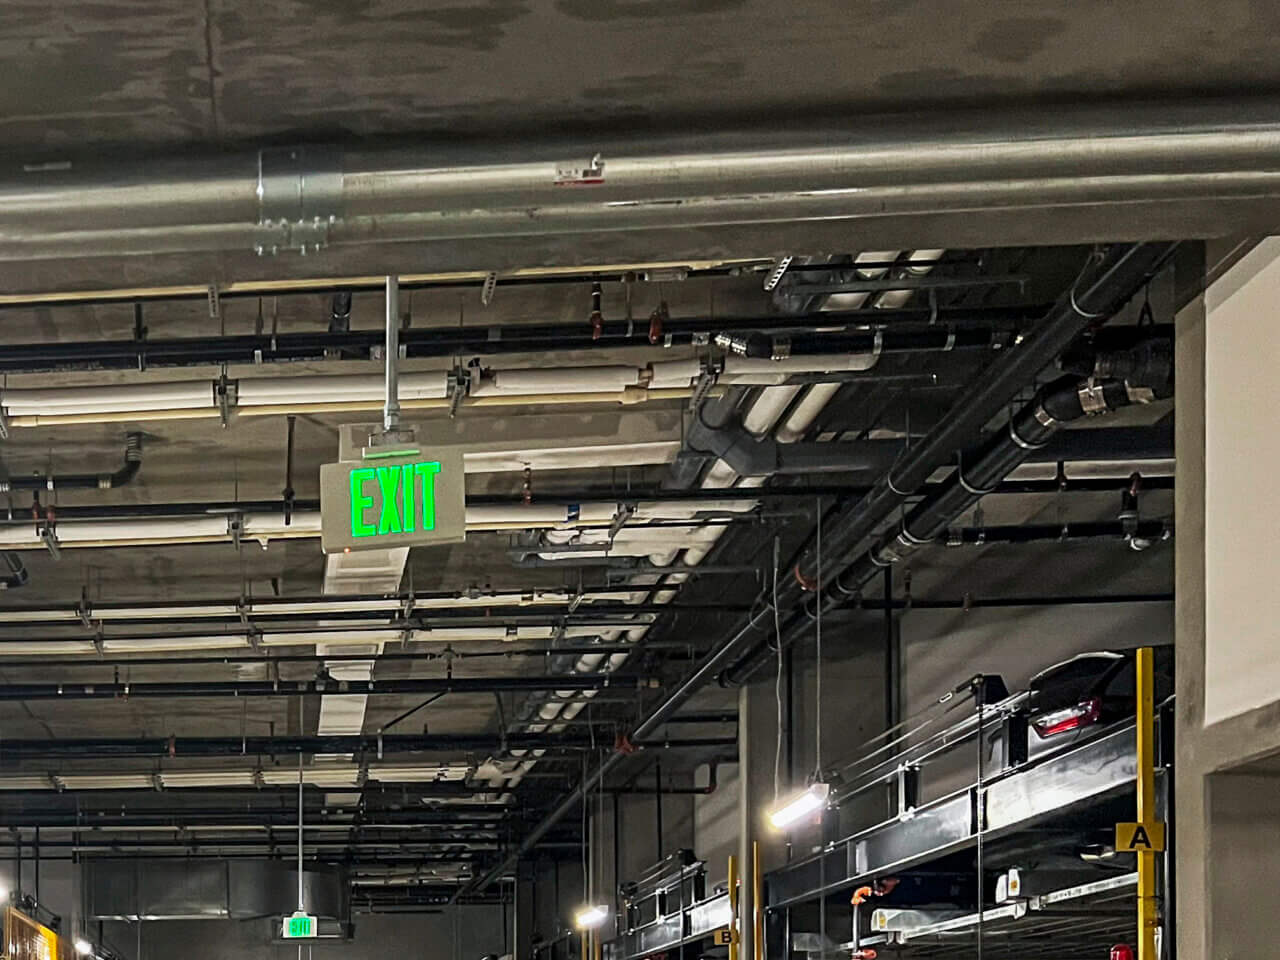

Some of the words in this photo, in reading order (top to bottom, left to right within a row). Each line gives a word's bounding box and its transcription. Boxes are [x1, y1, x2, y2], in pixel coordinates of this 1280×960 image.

[350, 461, 441, 537] EXIT
[1129, 825, 1152, 849] A
[721, 931, 732, 944] B
